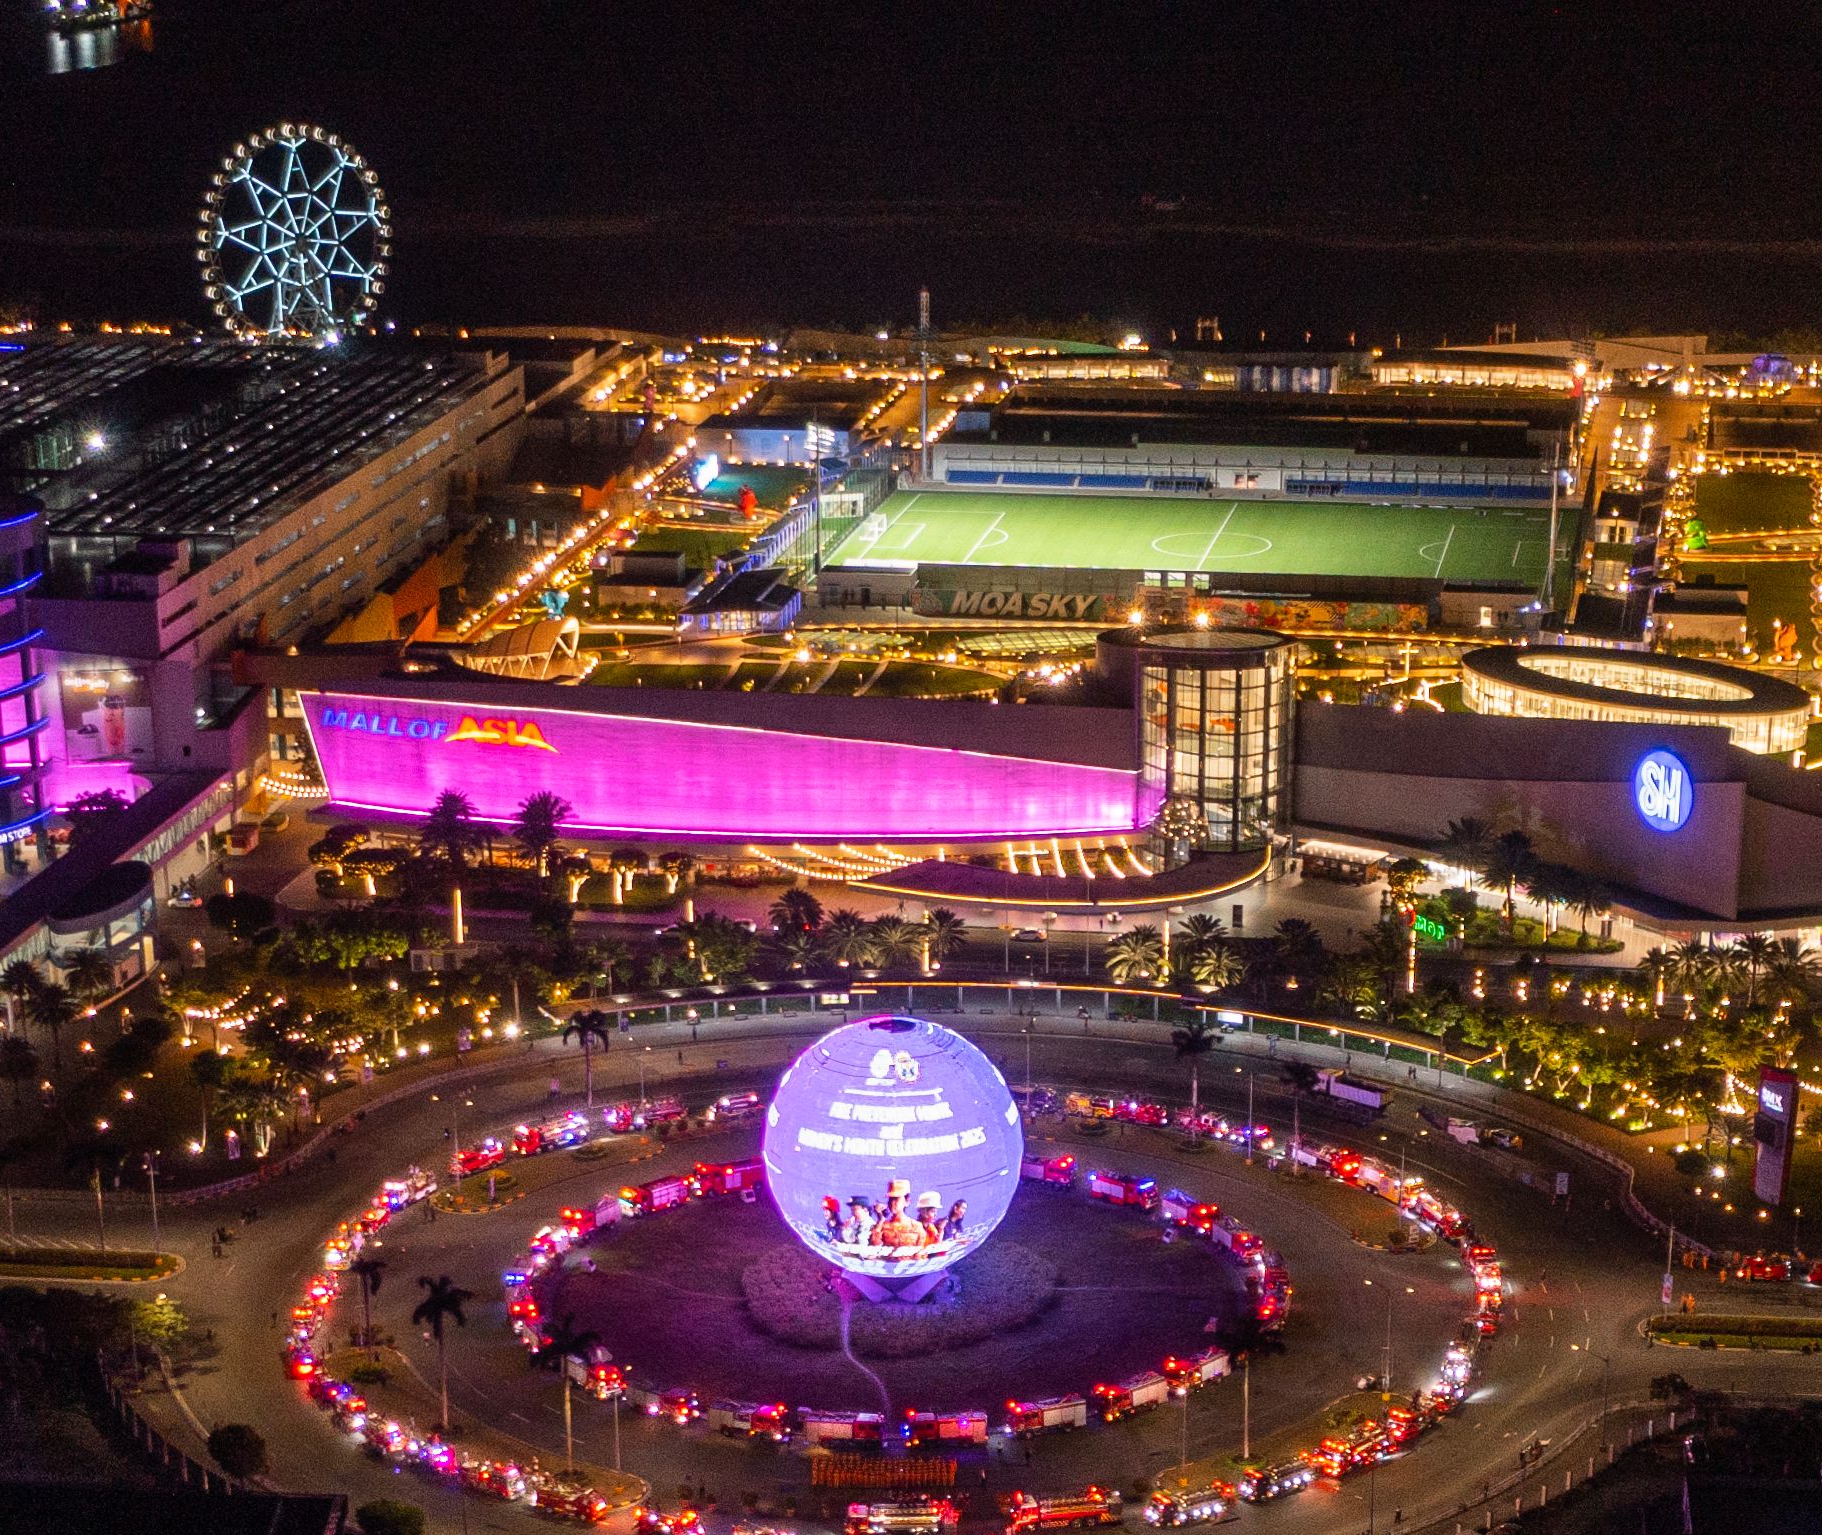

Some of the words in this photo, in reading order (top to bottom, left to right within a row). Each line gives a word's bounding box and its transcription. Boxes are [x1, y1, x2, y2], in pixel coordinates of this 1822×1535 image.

[949, 589, 1023, 617] MOA
[1027, 592, 1098, 619] SKY
[321, 706, 404, 737] MALL
[406, 718, 449, 741] OF
[453, 715, 553, 750] ASIA
[1638, 759, 1683, 824] SM
[7, 825, 33, 842] STORE
